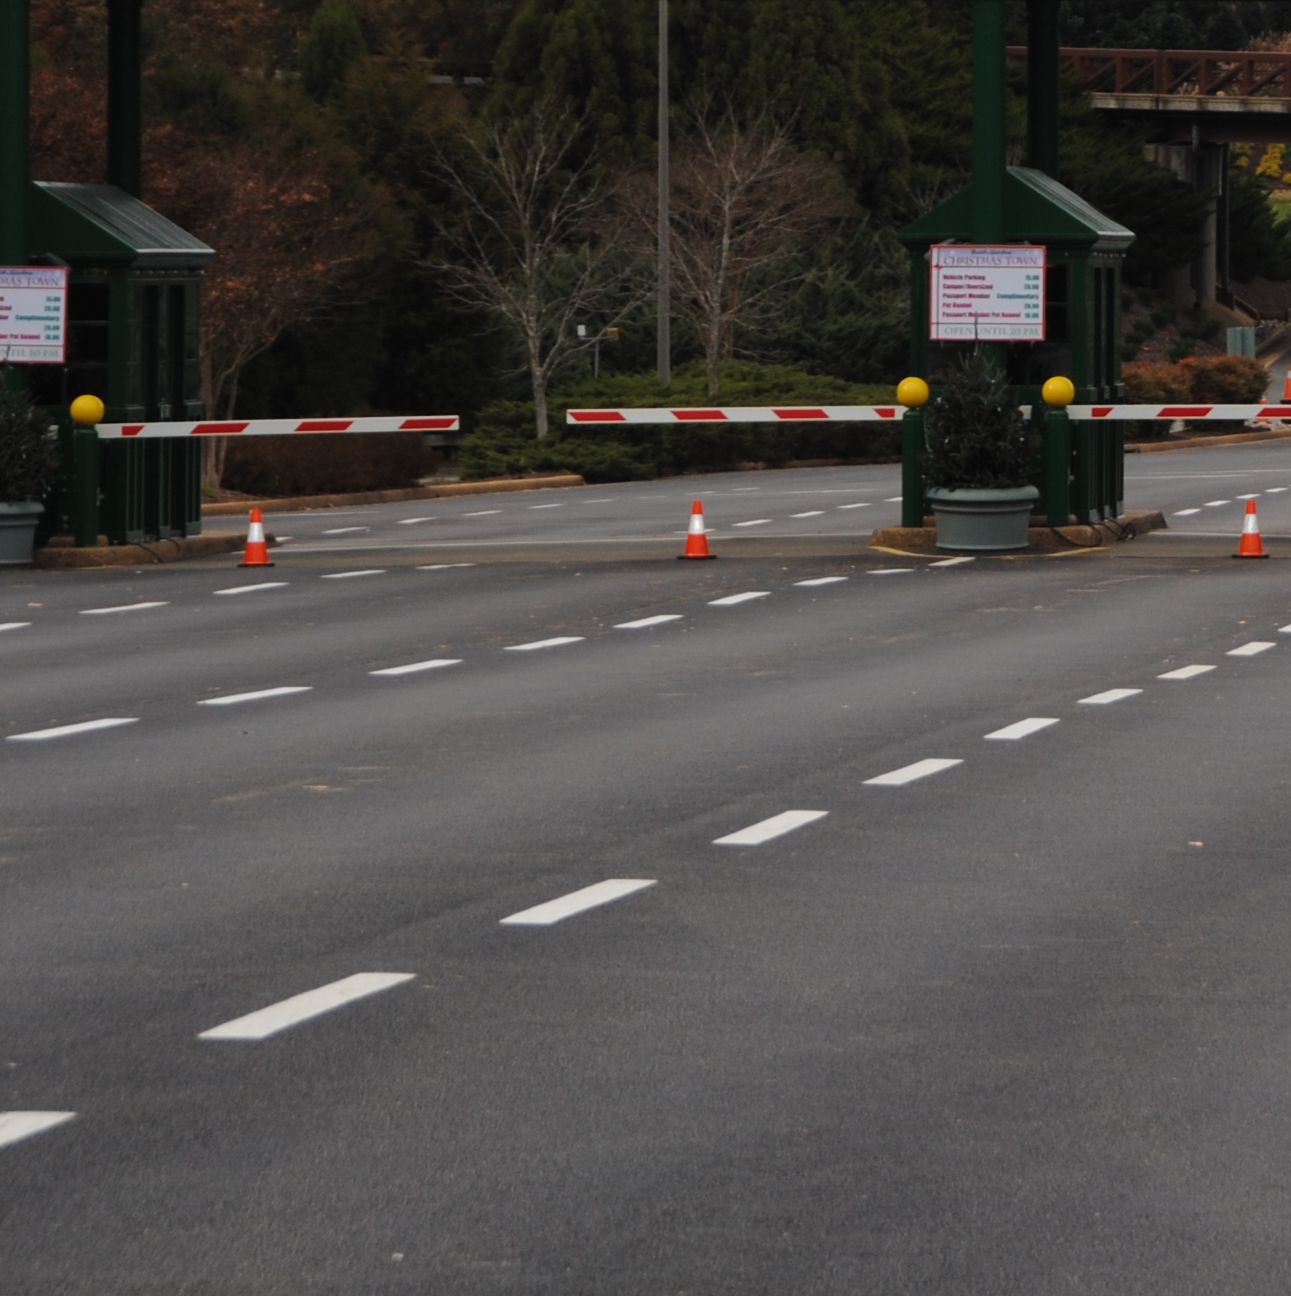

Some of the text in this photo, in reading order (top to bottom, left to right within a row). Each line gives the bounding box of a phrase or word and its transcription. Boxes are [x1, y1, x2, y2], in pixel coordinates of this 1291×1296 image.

[944, 256, 1037, 265] CHRISTMAS TOWN
[944, 327, 972, 335] OPEN
